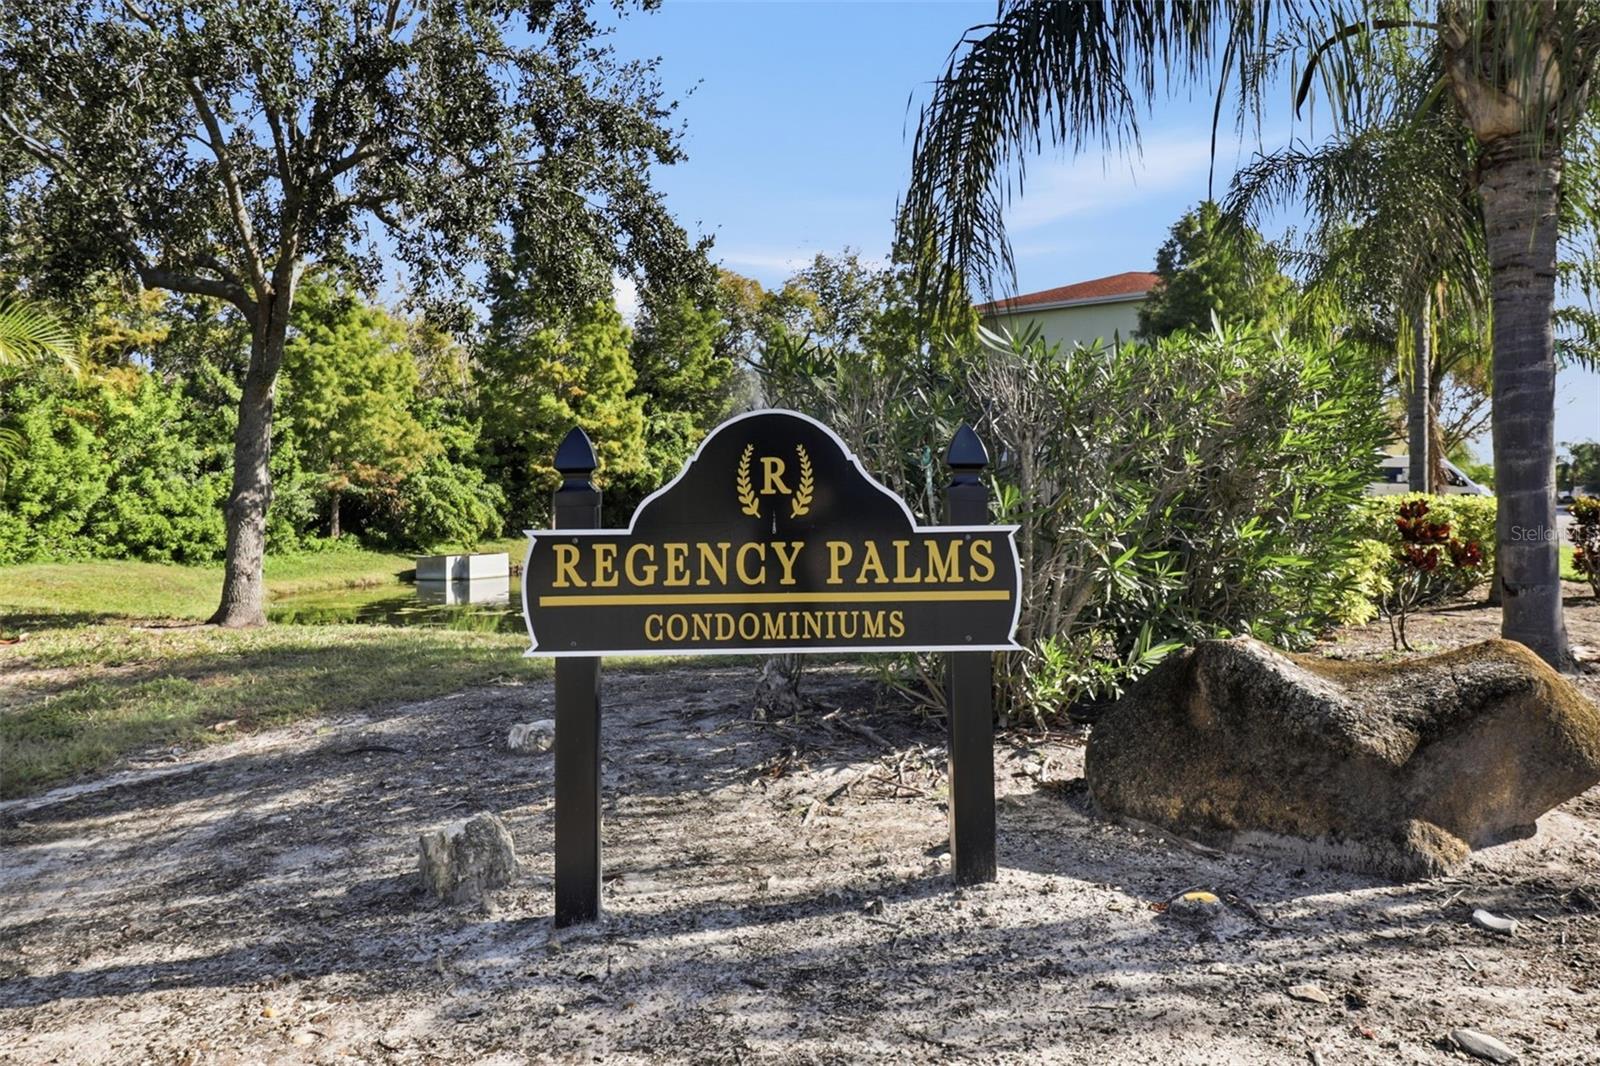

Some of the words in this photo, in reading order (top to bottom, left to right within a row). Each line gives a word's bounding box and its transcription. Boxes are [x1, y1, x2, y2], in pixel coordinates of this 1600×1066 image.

[760, 456, 791, 495] R
[552, 541, 805, 588] REGENCY
[826, 539, 995, 585] PALMS
[644, 610, 905, 642] CONDOMINIUMS
